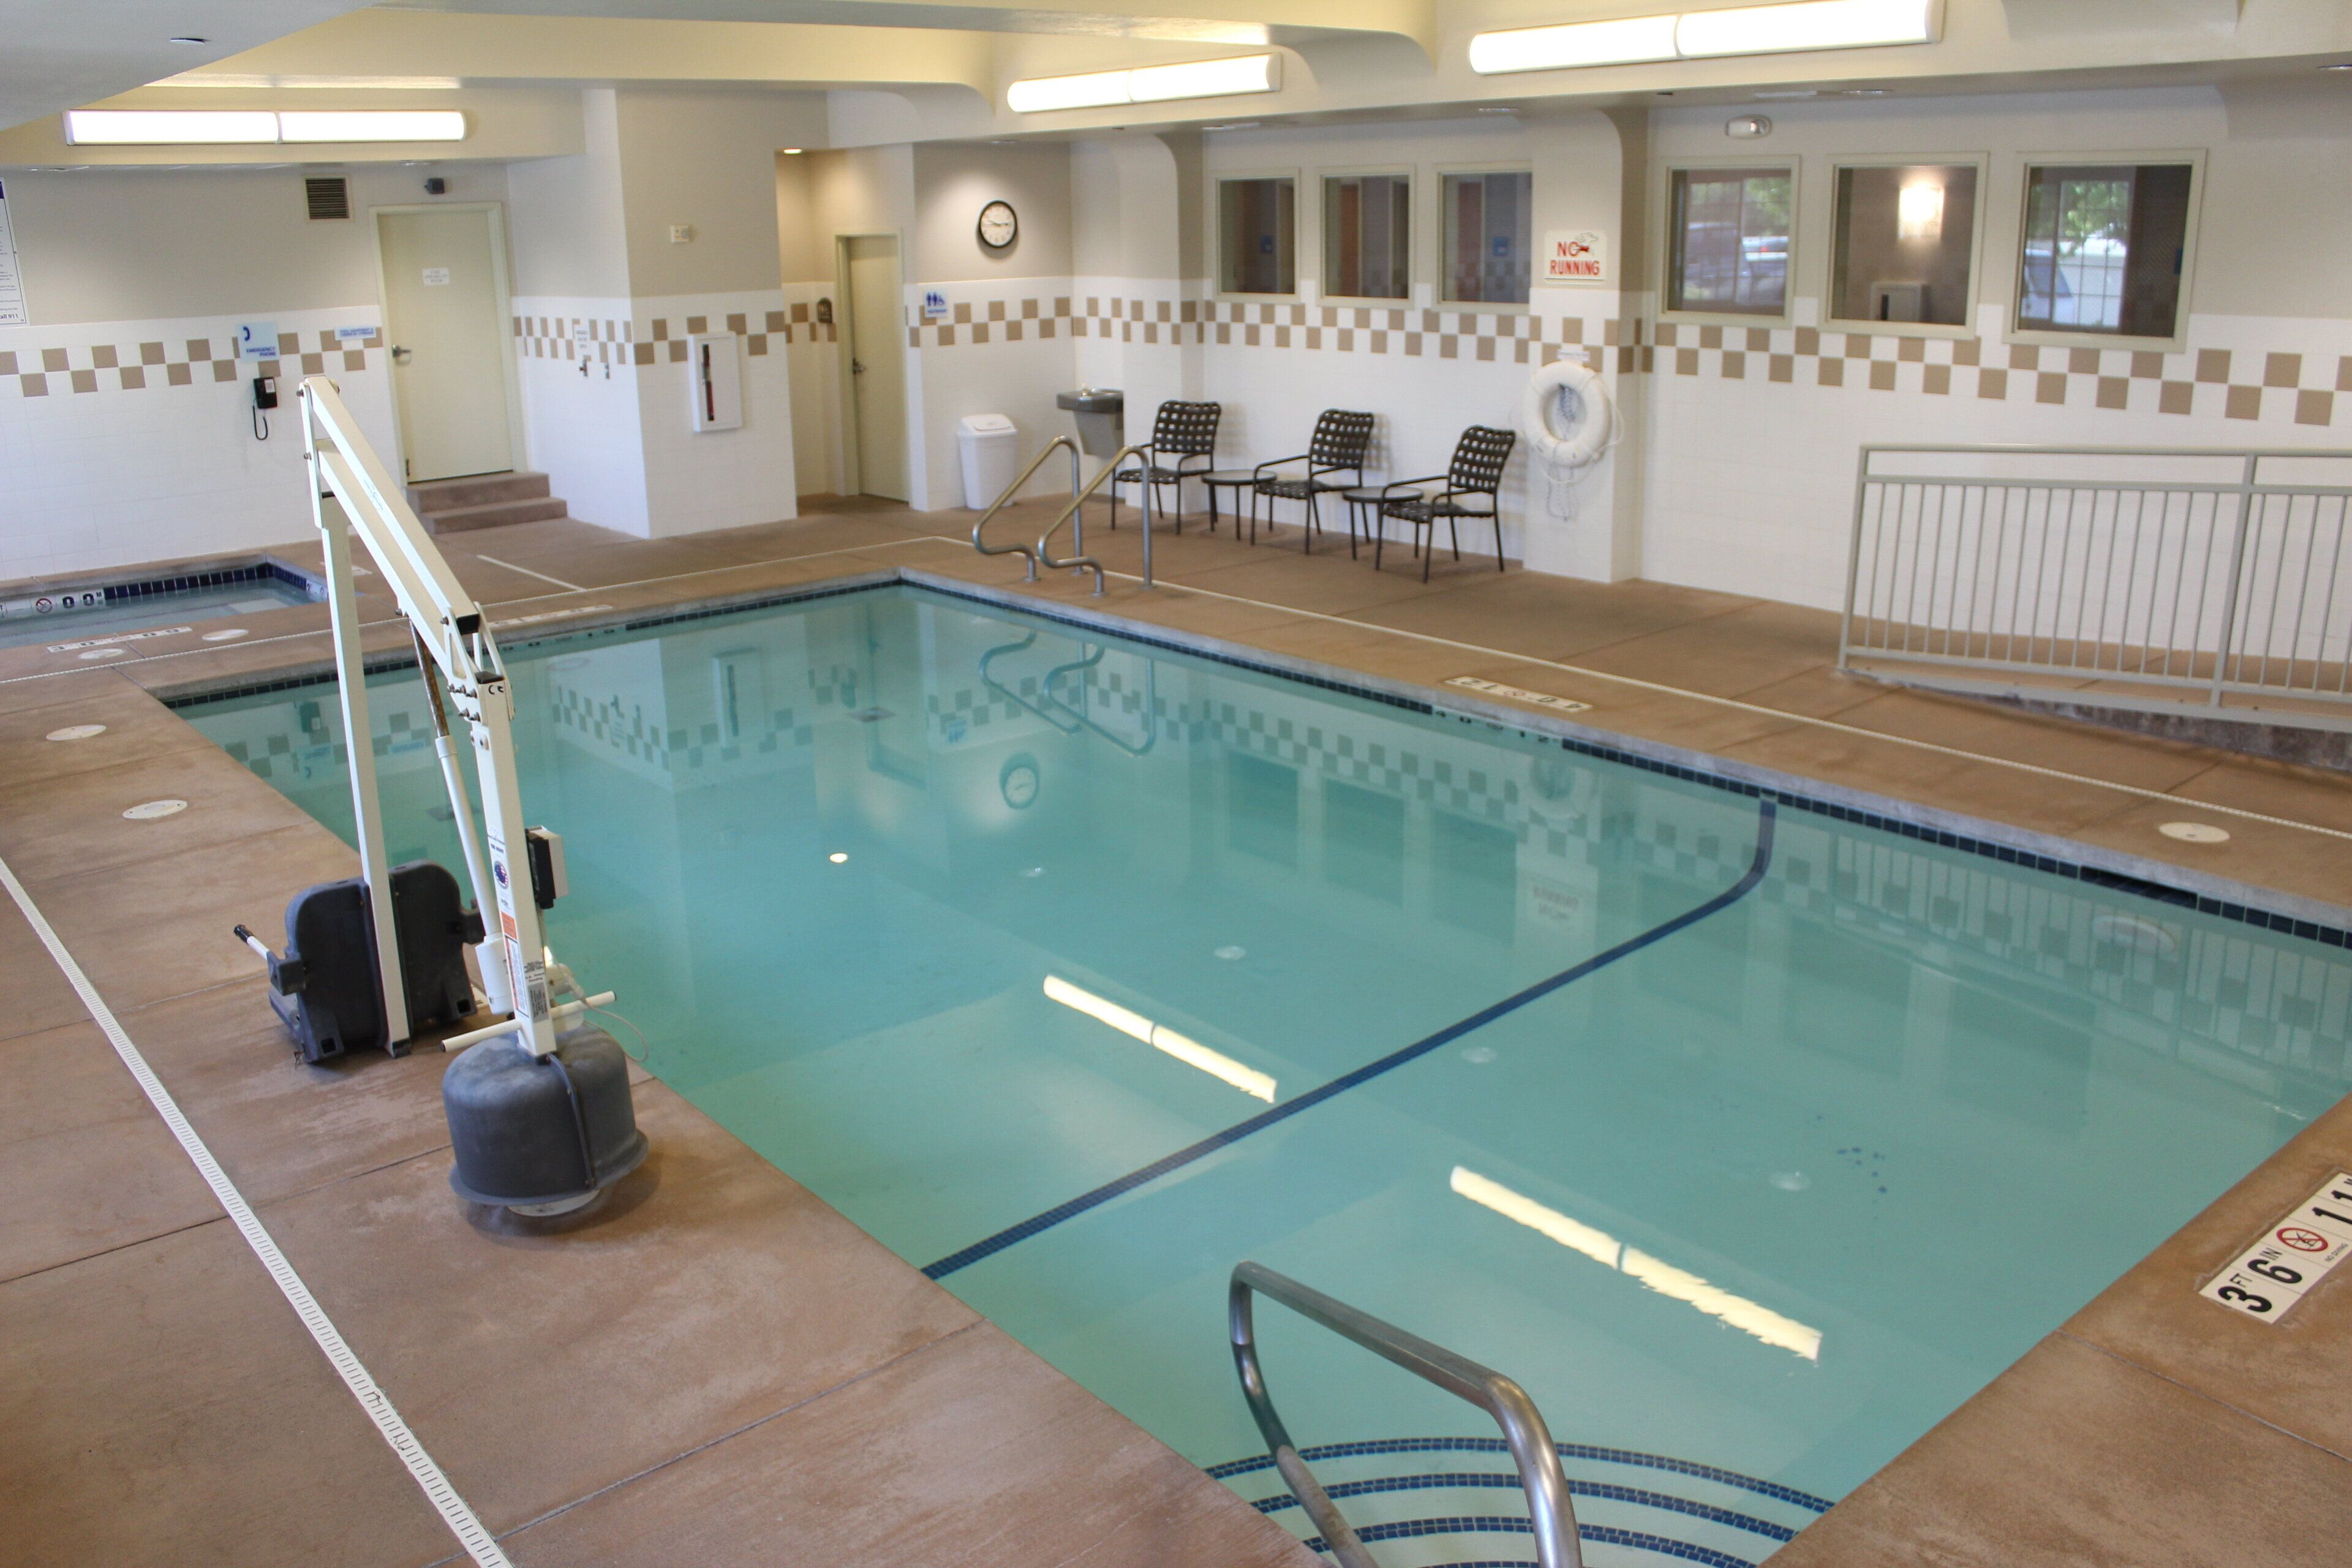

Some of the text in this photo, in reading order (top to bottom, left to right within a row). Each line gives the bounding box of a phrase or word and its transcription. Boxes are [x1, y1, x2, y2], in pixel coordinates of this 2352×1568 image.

[1558, 241, 1578, 257] NO
[1550, 260, 1599, 275] RUNNING
[2217, 1247, 2303, 1313] 3 FT 6 IN
